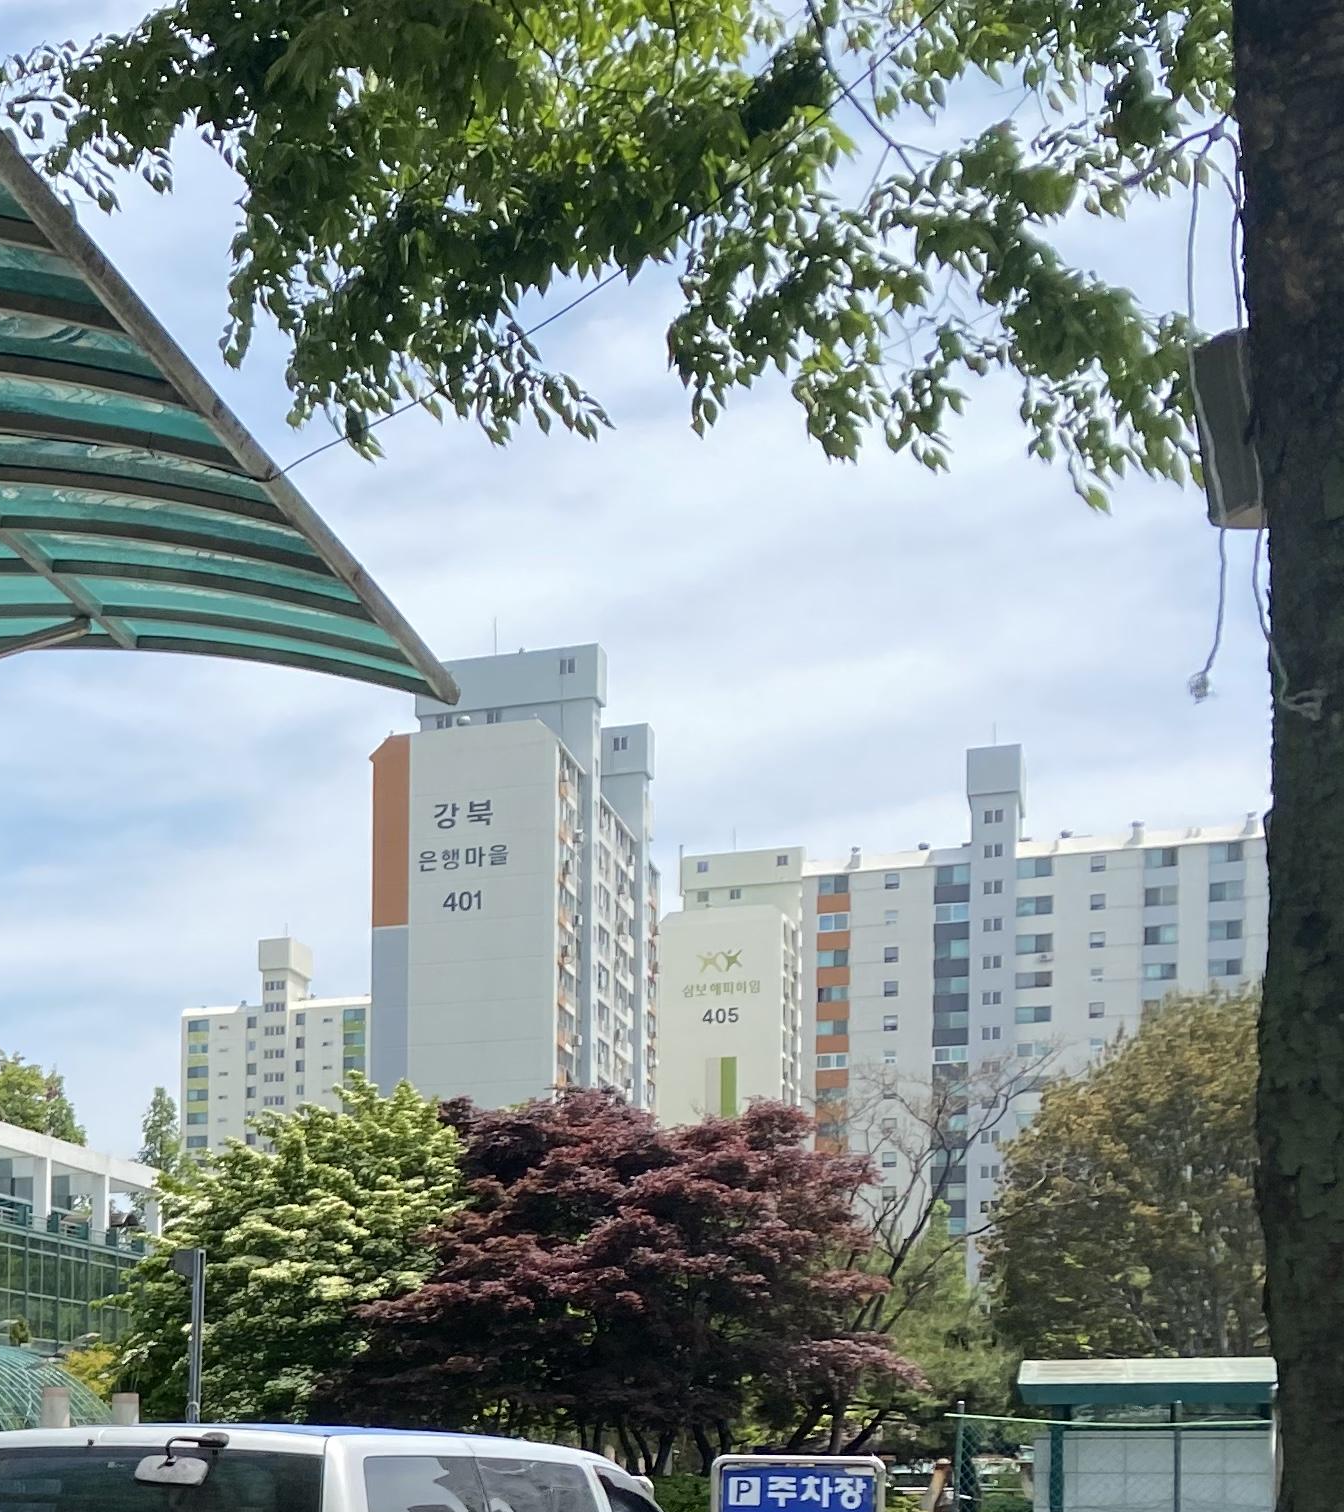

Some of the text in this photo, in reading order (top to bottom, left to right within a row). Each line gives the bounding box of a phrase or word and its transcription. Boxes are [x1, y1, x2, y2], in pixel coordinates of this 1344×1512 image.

[418, 844, 509, 872] 은행마을
[442, 890, 481, 912] 401
[702, 1007, 739, 1024] 405
[767, 1476, 867, 1510] 주차장
